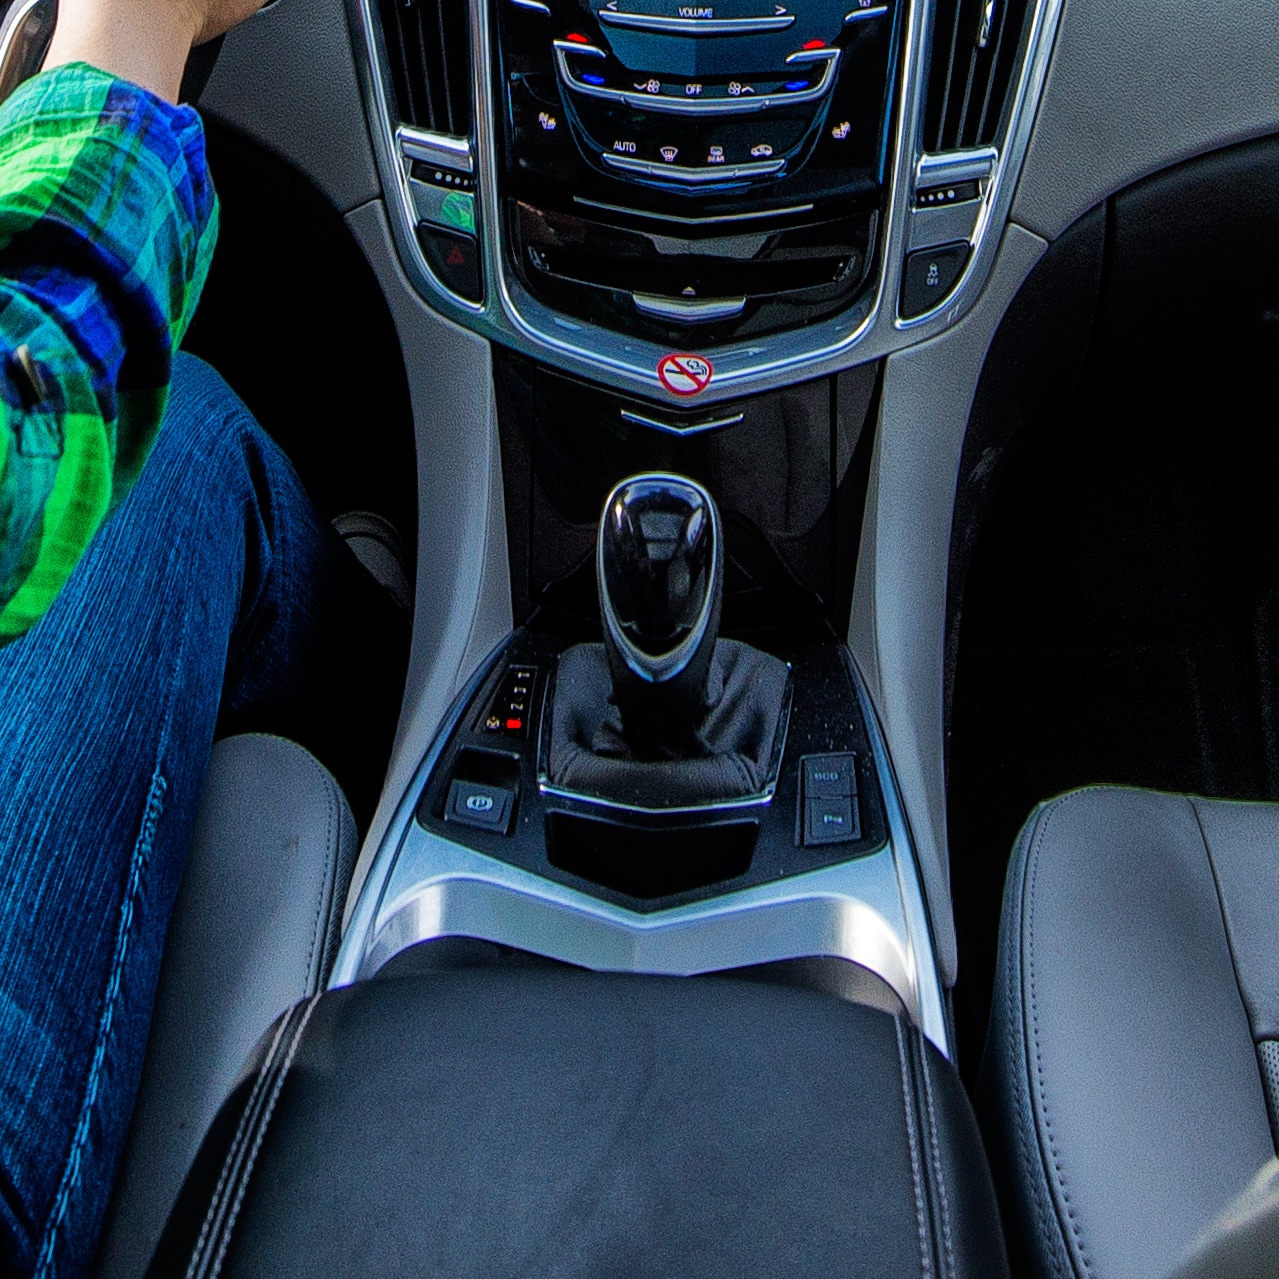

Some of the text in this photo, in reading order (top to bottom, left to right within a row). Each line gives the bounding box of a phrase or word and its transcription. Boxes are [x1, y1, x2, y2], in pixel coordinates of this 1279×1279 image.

[678, 6, 714, 18] VOLUME
[685, 84, 702, 95] OFF
[613, 140, 637, 152] AUTO
